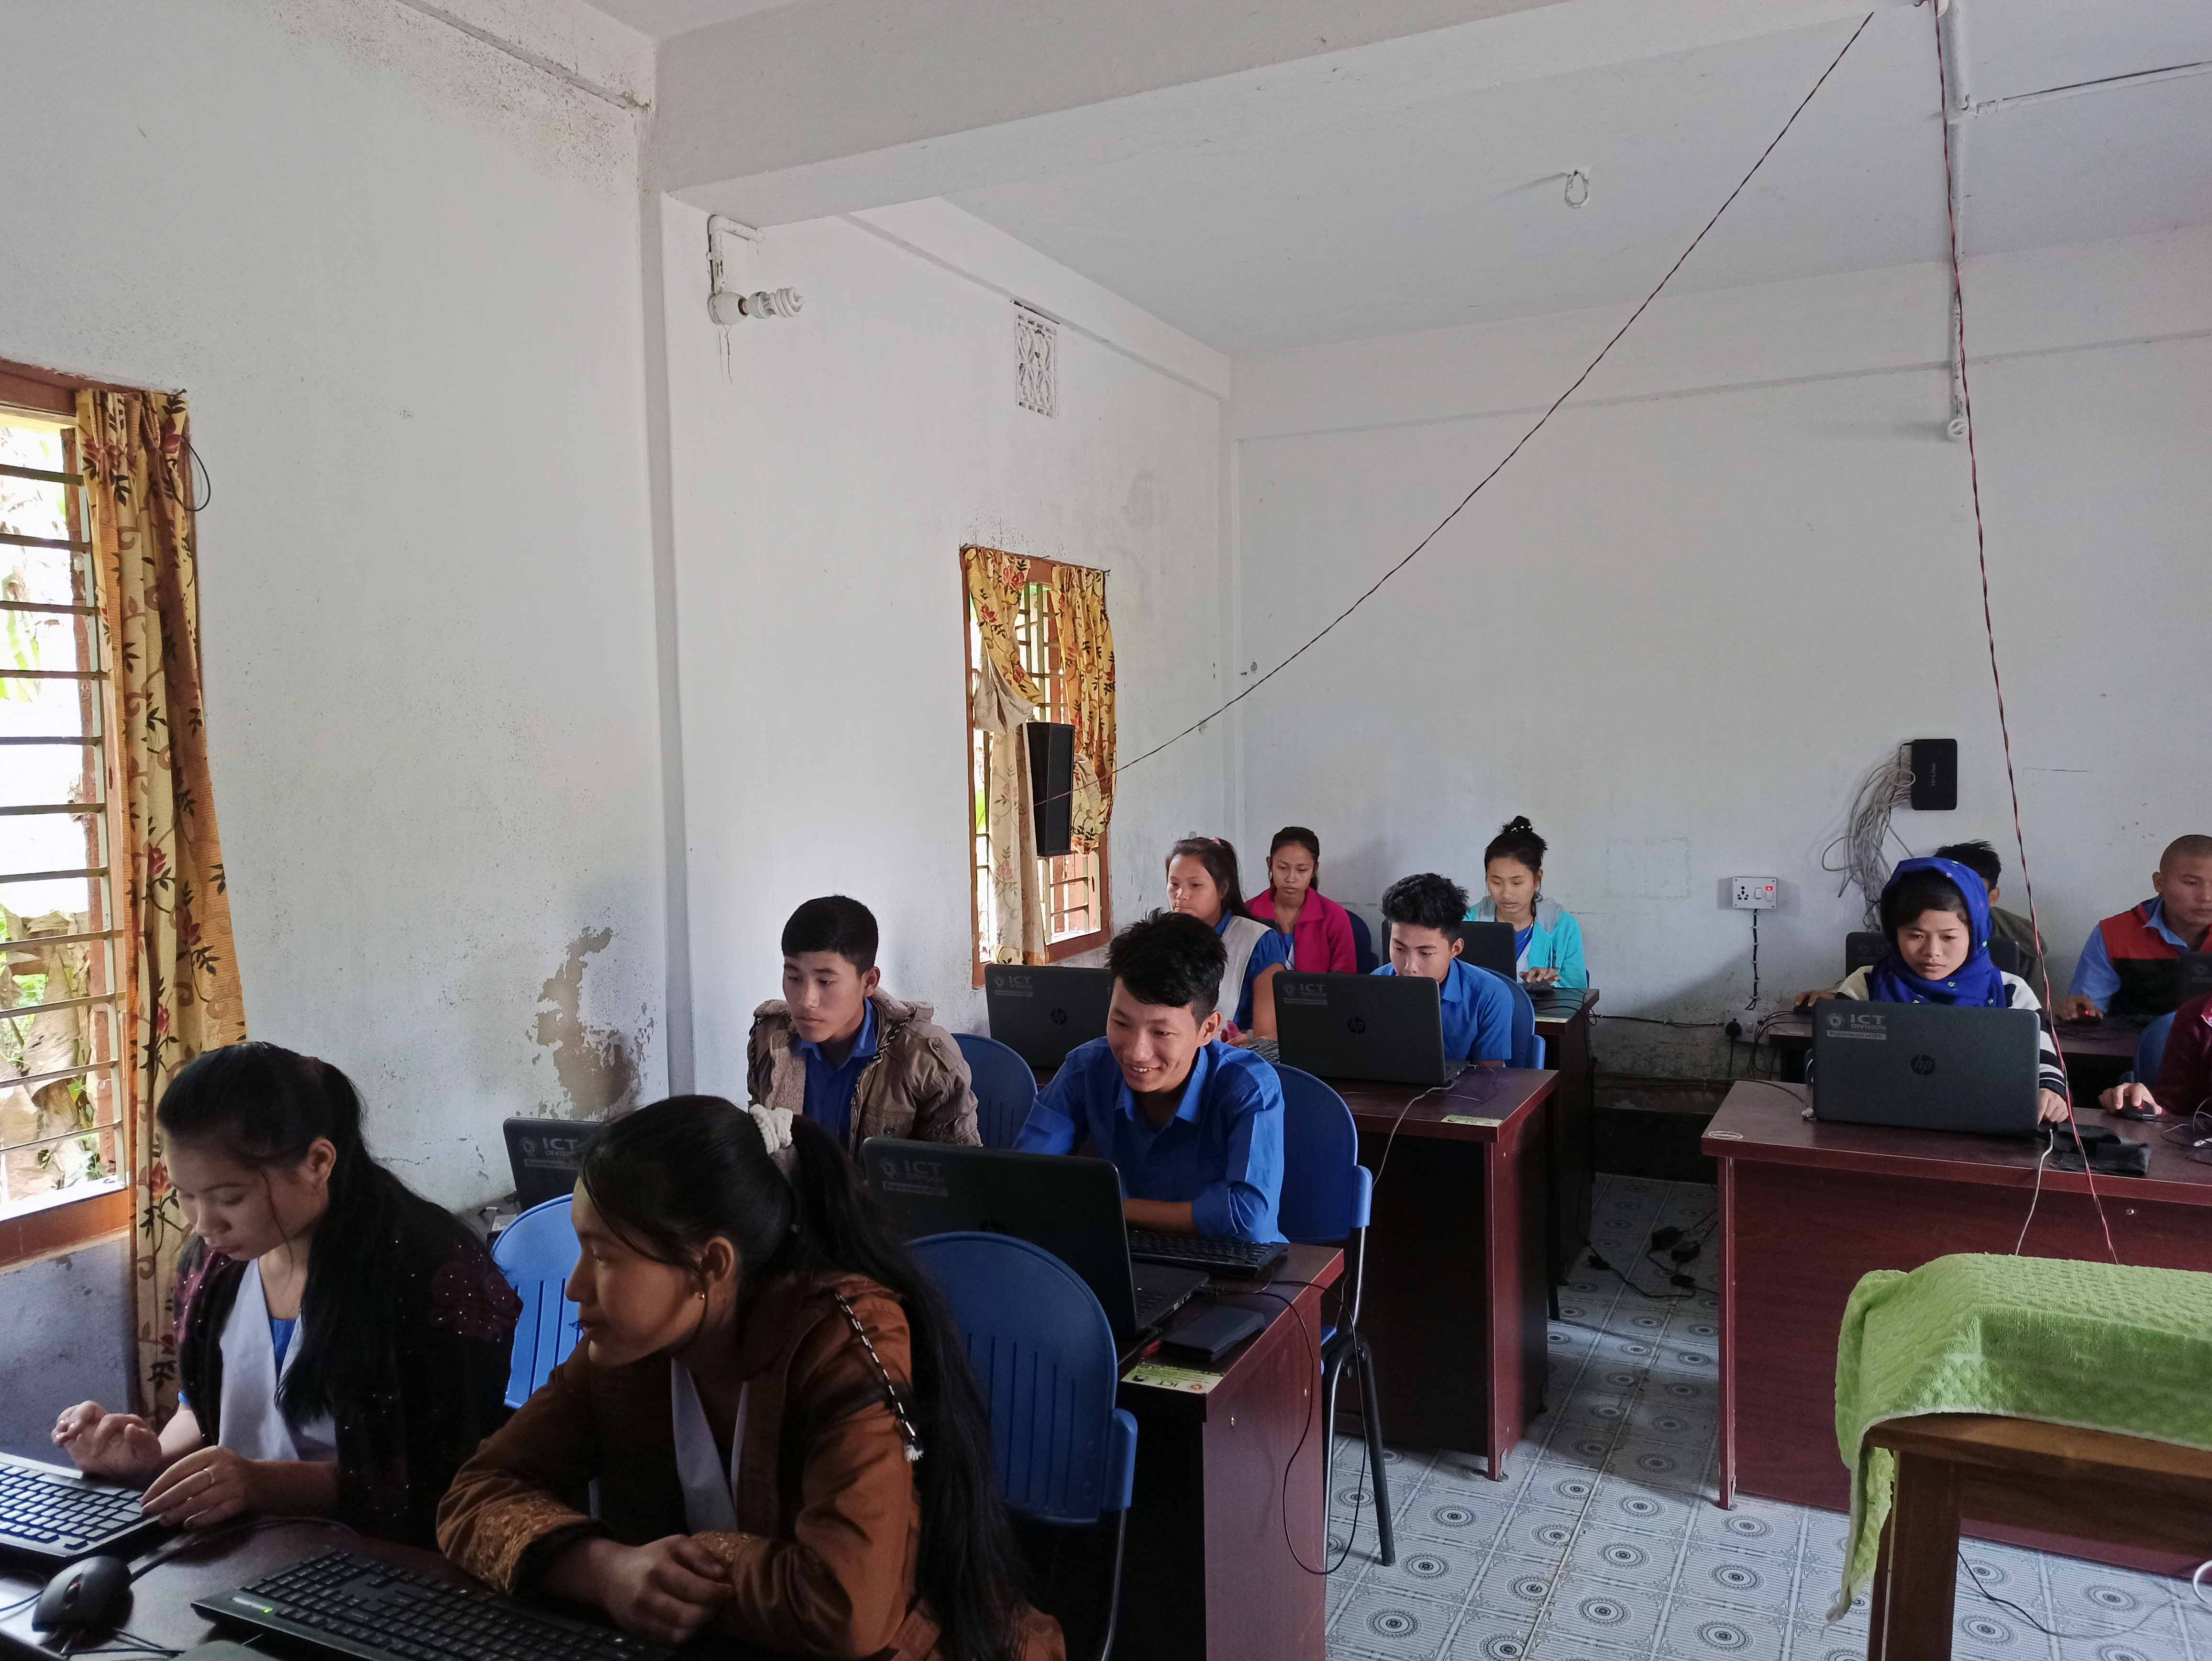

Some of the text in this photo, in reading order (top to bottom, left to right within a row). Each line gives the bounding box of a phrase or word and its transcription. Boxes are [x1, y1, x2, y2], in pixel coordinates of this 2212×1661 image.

[1300, 983, 1327, 992] ICT
[1349, 1017, 1365, 1035] hp
[1850, 1013, 1886, 1025] ICT
[1912, 1054, 1934, 1075] hp
[542, 1137, 578, 1150] ICT
[903, 1159, 942, 1175] ICT
